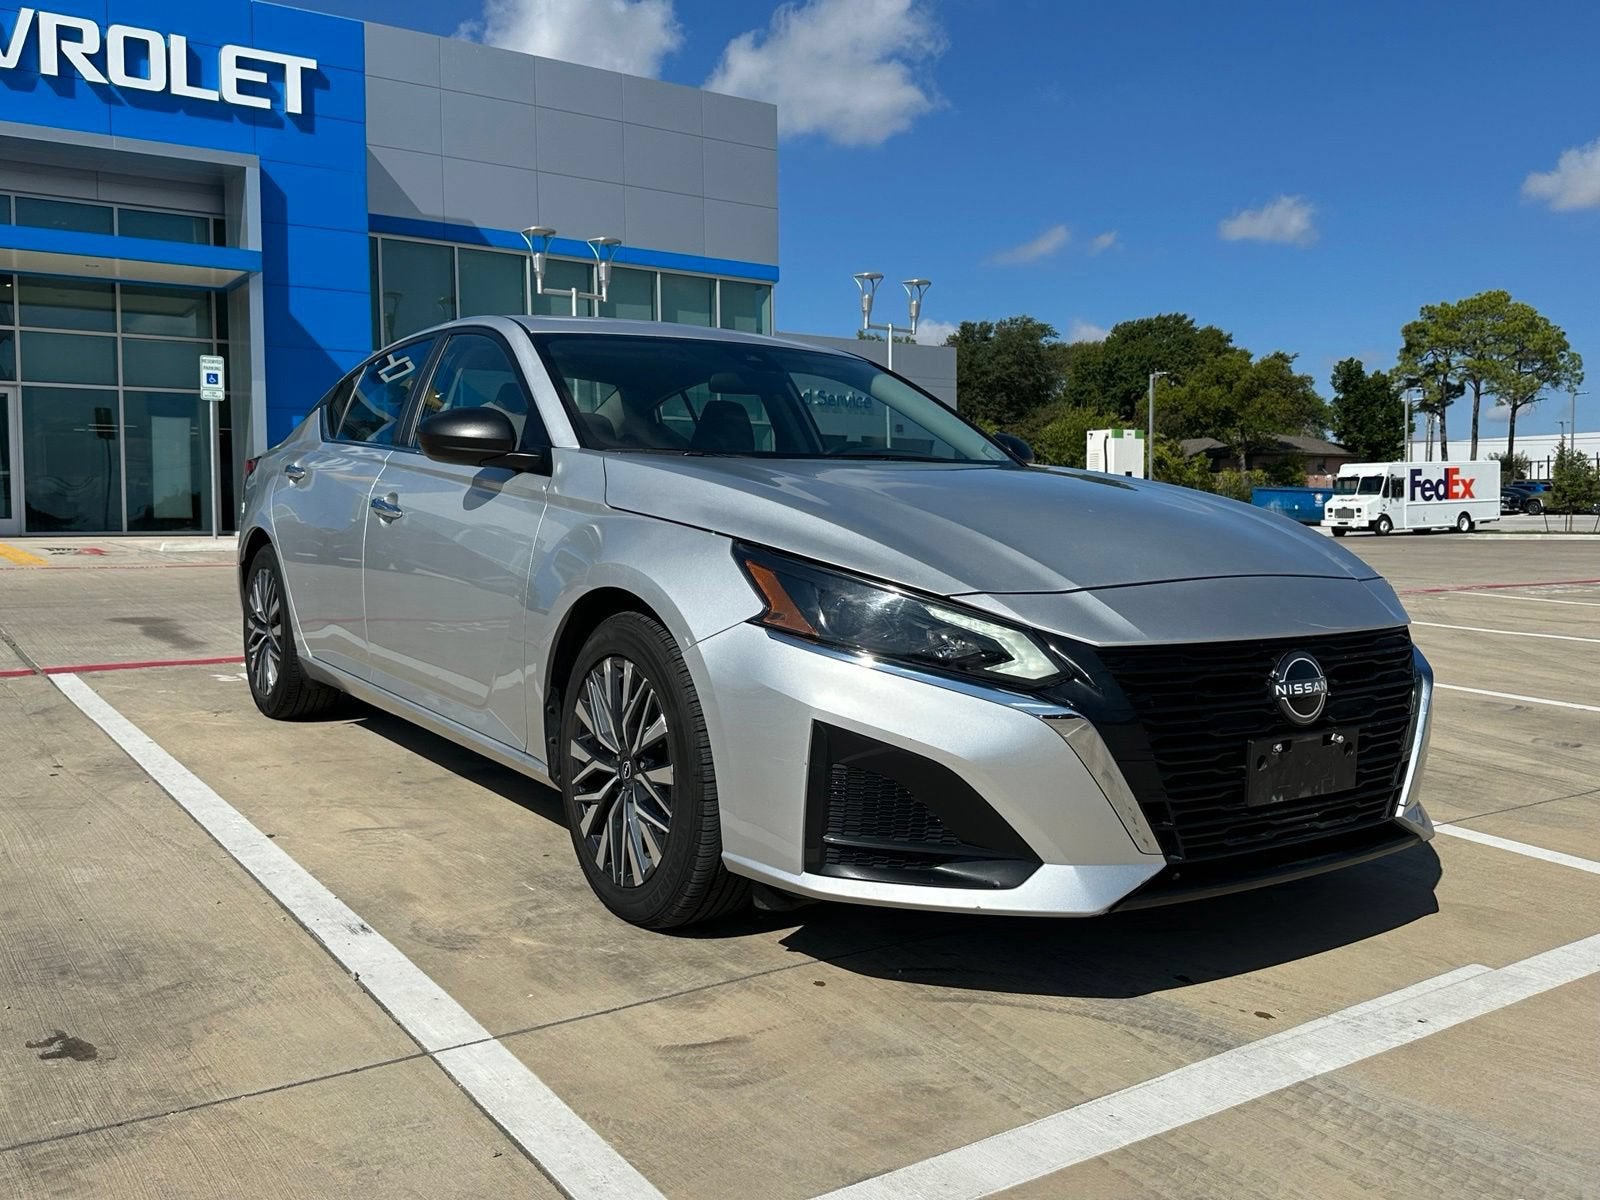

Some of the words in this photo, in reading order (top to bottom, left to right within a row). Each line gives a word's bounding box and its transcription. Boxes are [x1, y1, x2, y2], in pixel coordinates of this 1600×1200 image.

[814, 390, 872, 409] Service
[1410, 466, 1476, 501] FedEx
[1275, 681, 1328, 696] NISSAN
